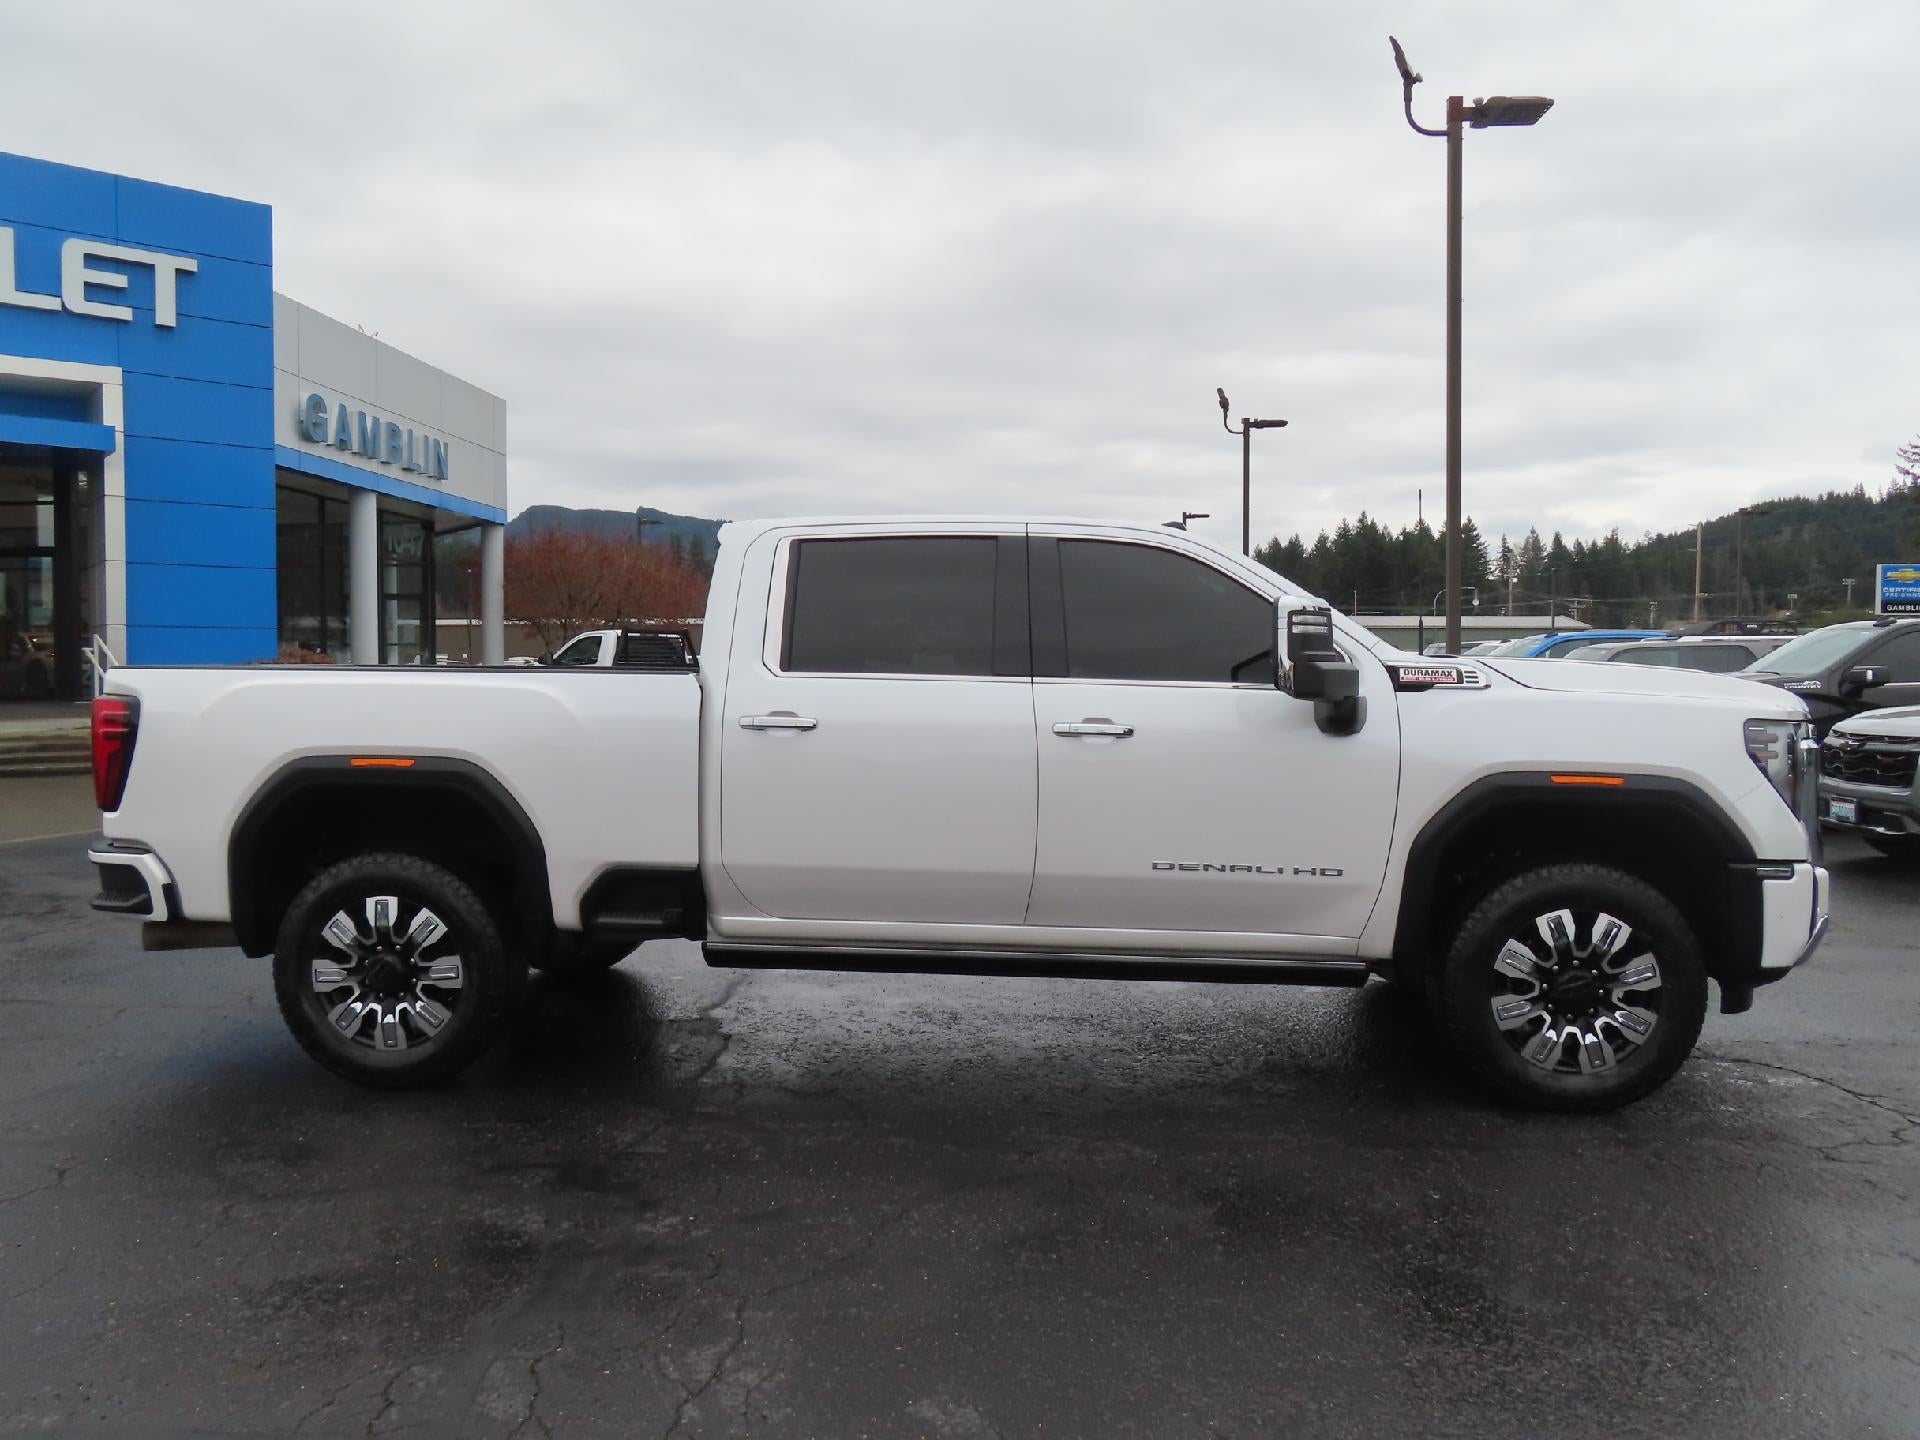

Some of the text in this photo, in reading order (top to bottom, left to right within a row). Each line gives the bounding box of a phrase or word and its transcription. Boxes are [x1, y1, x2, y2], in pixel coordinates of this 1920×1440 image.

[303, 393, 448, 481] GAMBLIN
[1403, 668, 1453, 677] DURAMAX
[1152, 862, 1343, 877] DENALI HD
